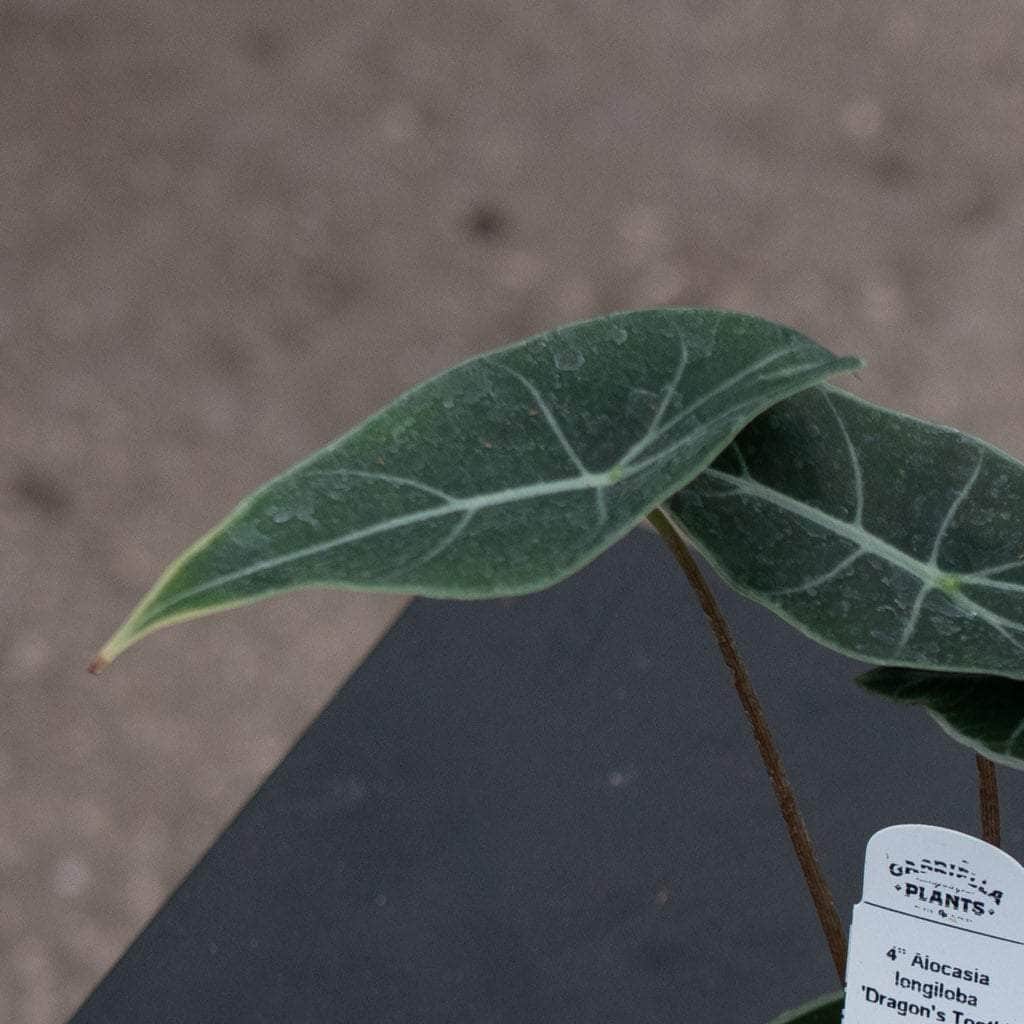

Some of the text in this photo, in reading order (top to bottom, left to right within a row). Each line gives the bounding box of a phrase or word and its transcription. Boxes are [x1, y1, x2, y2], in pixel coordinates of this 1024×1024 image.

[905, 883, 985, 916] PLANTS
[861, 985, 946, 1022] 'Dragon's
[895, 971, 977, 1007] longiloba
